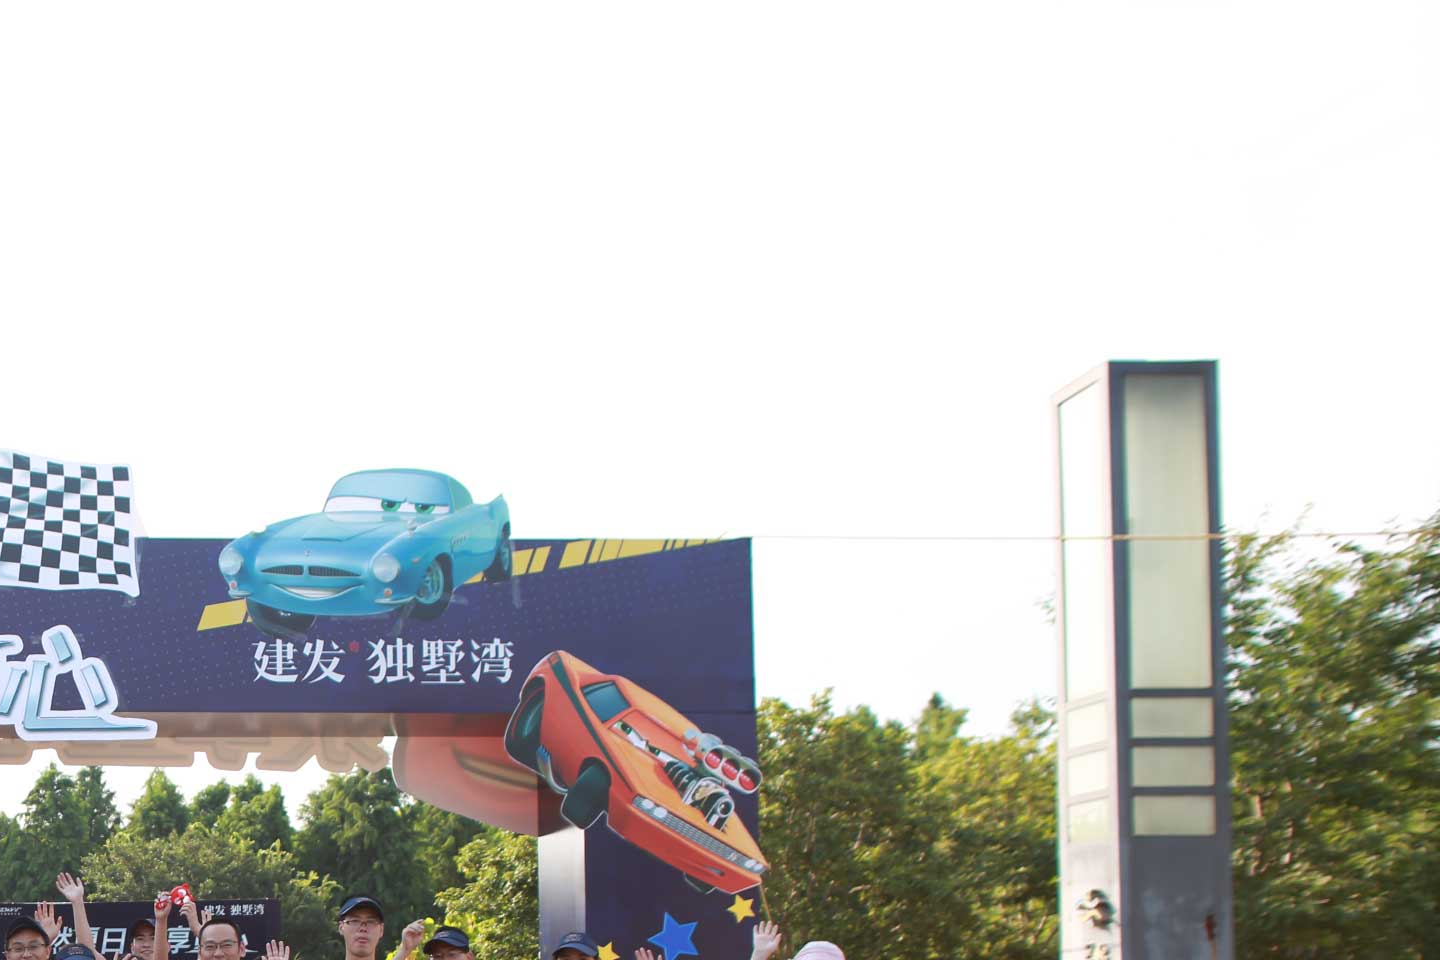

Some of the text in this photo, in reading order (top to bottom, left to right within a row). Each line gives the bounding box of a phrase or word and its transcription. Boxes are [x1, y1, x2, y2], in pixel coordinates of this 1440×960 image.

[251, 636, 516, 685] 建发 独墅湾
[230, 903, 265, 916] 独墅湾
